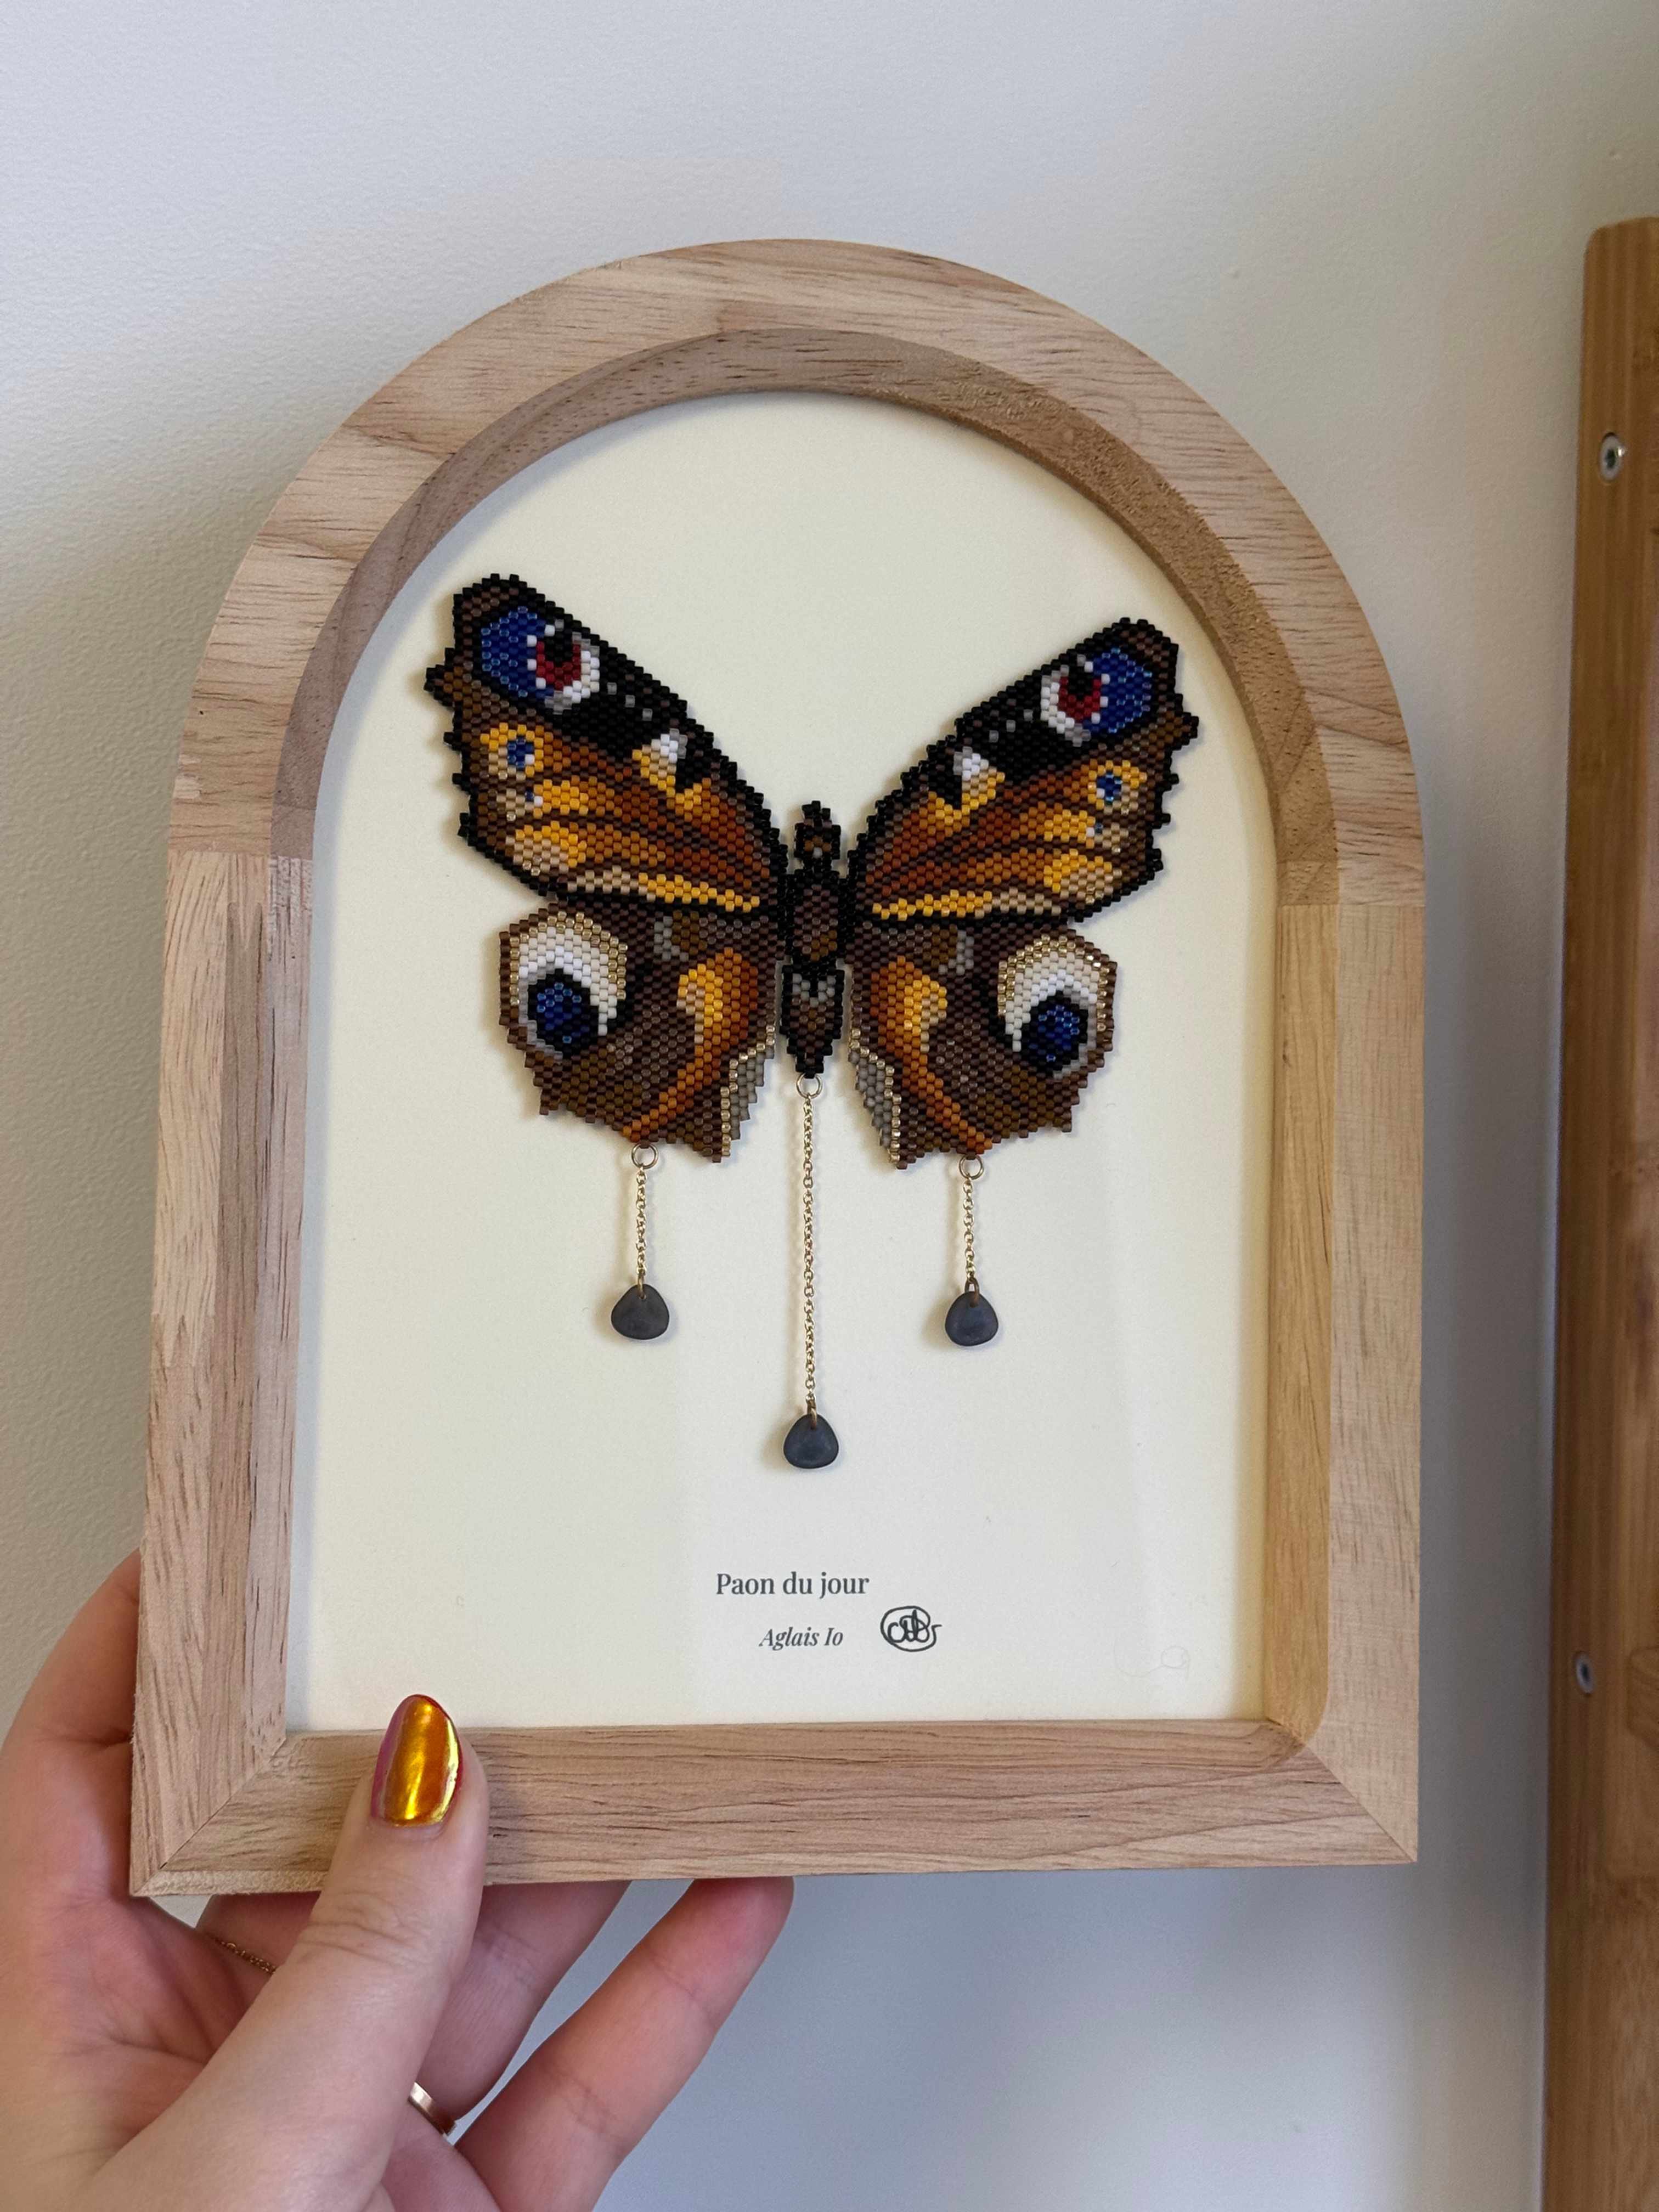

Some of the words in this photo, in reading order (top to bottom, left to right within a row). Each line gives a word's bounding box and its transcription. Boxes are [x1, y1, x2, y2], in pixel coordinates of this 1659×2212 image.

[716, 1573, 776, 1595] Paon
[782, 1571, 813, 1595] du
[819, 1571, 870, 1599] jour
[759, 1626, 820, 1651] Aglais
[823, 1627, 844, 1646] Io
